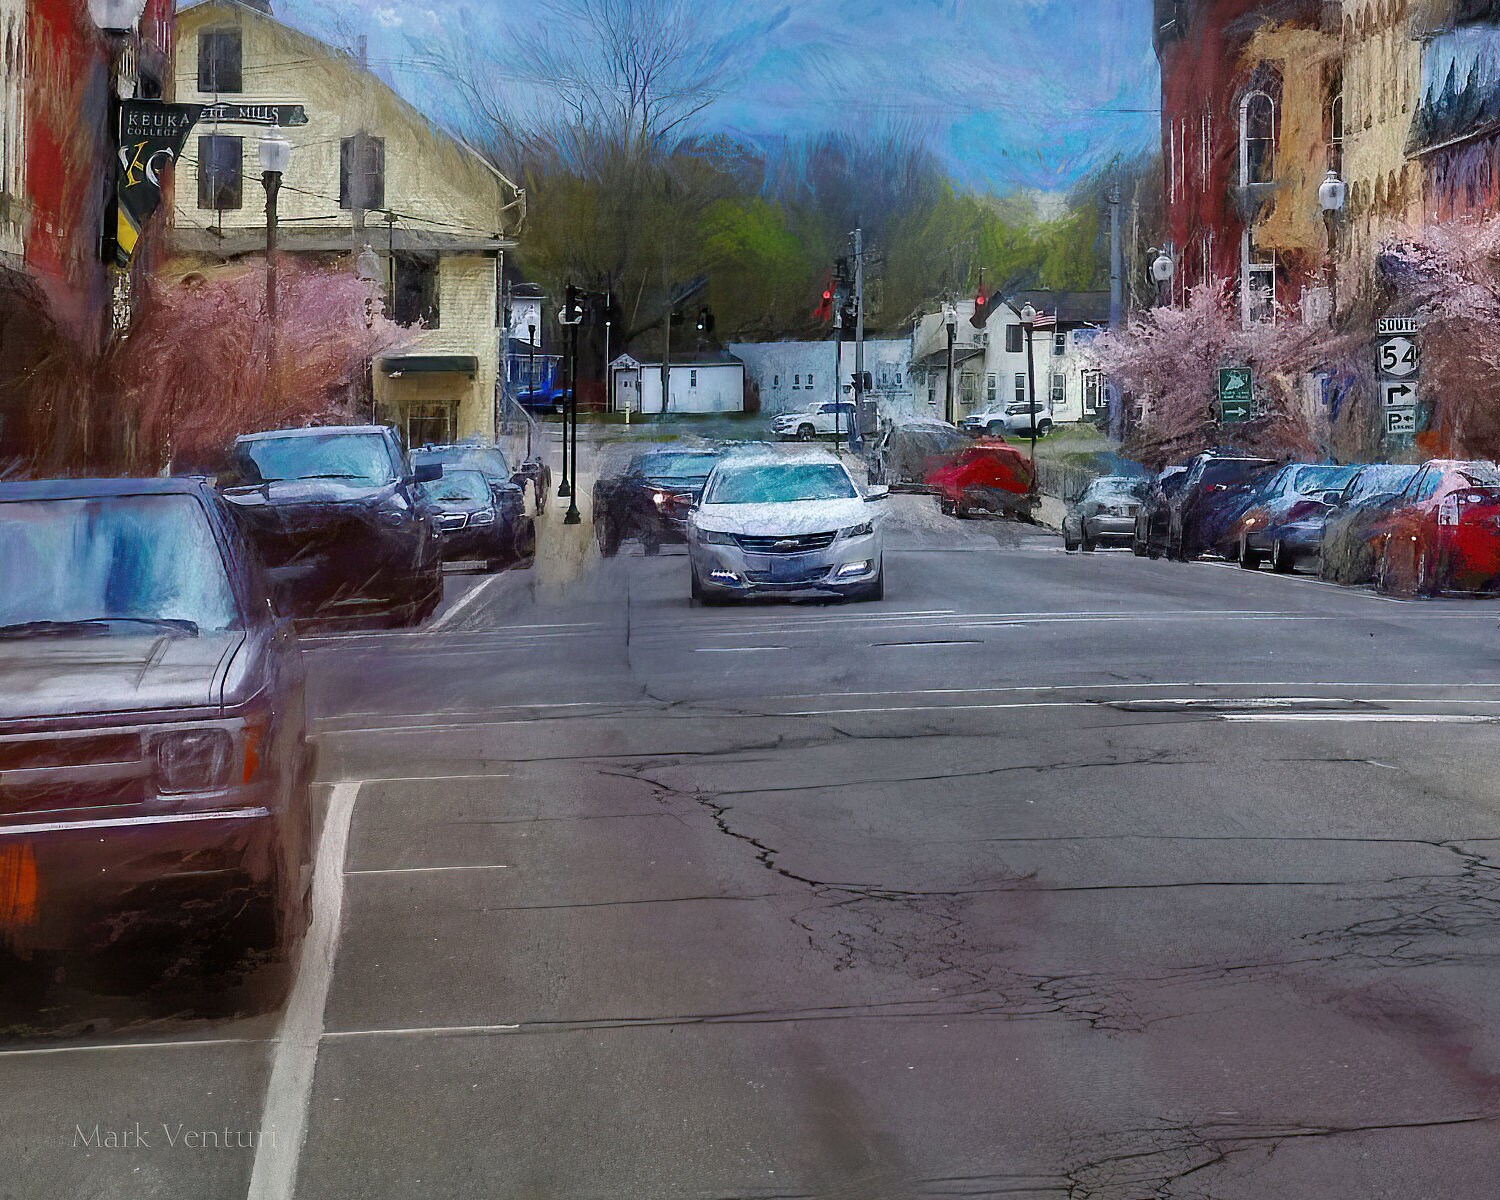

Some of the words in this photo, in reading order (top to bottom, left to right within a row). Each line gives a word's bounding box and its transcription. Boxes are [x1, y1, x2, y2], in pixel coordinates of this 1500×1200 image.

[128, 112, 191, 127] KEUKA
[239, 107, 279, 121] MILLS
[127, 127, 179, 137] COLLEGE
[1380, 319, 1418, 331] SOUTH
[1383, 345, 1417, 370] 54
